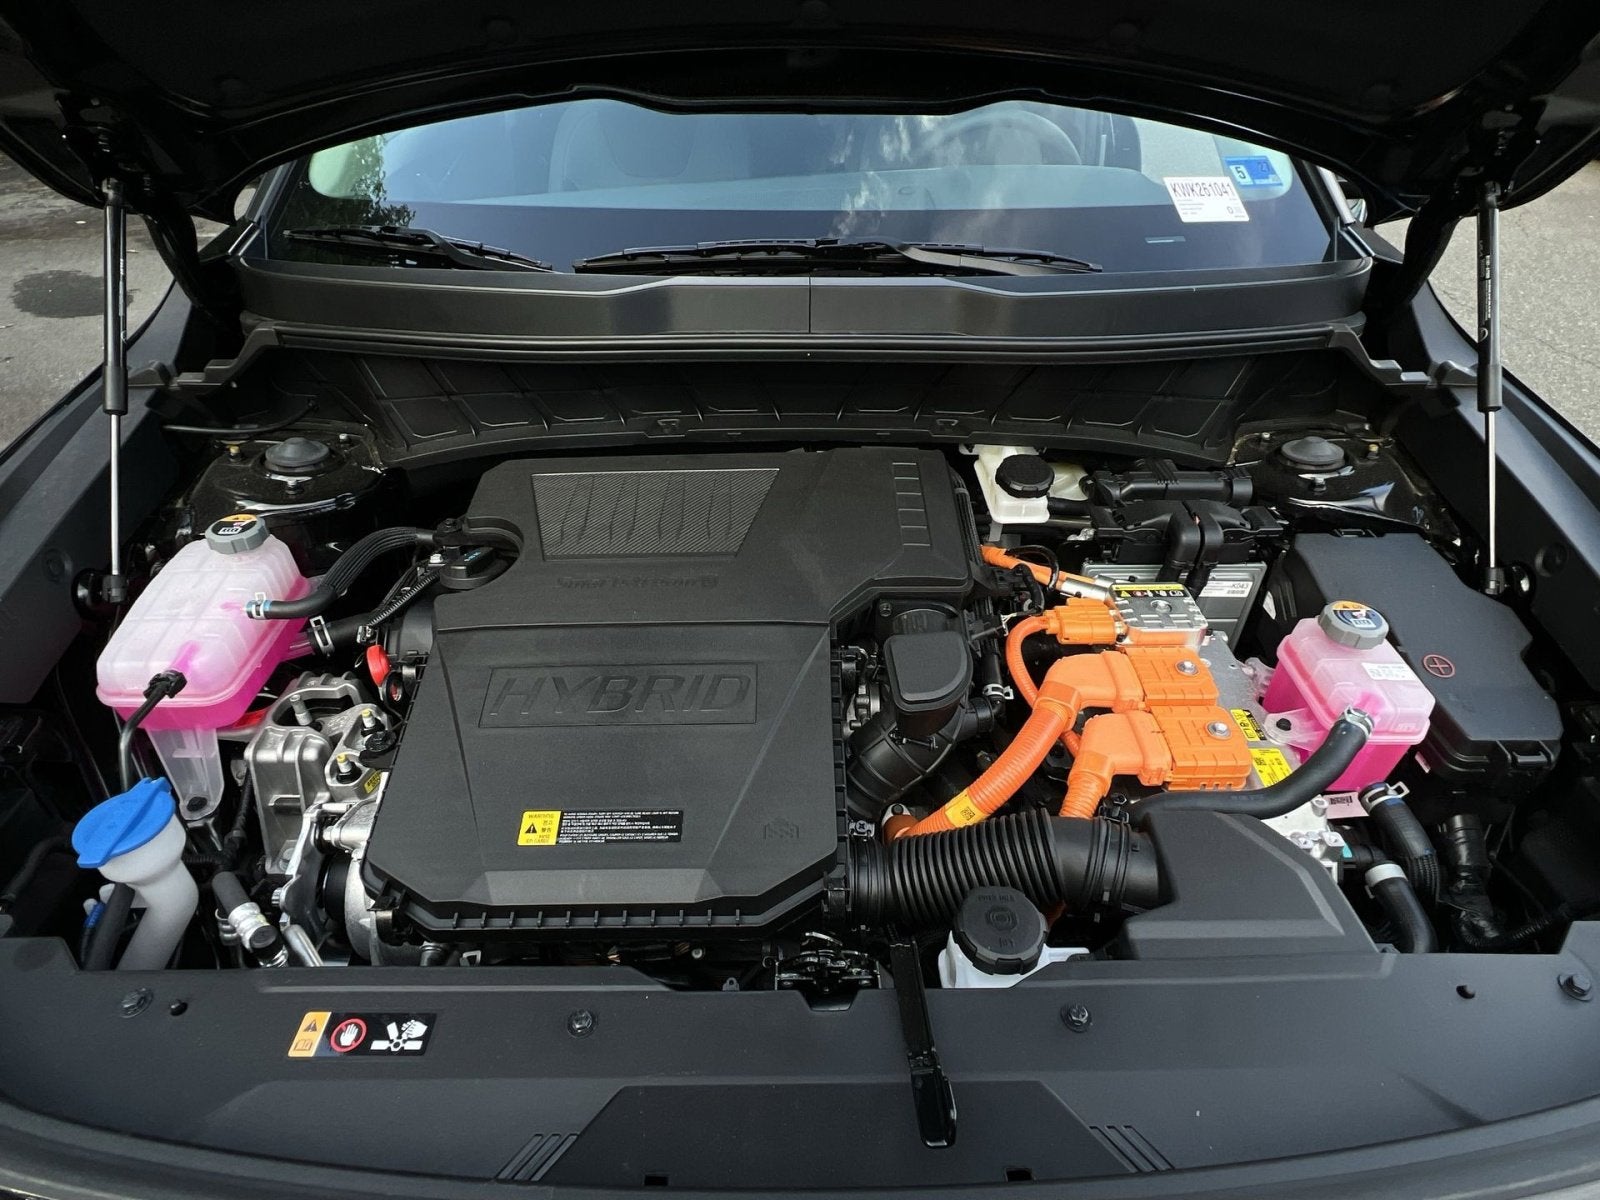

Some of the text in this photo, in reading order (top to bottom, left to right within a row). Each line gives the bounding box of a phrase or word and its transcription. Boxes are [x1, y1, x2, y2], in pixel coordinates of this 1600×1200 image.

[1234, 166, 1246, 179] 5
[1169, 182, 1236, 198] KWK261041
[489, 673, 751, 716] HYBRID
